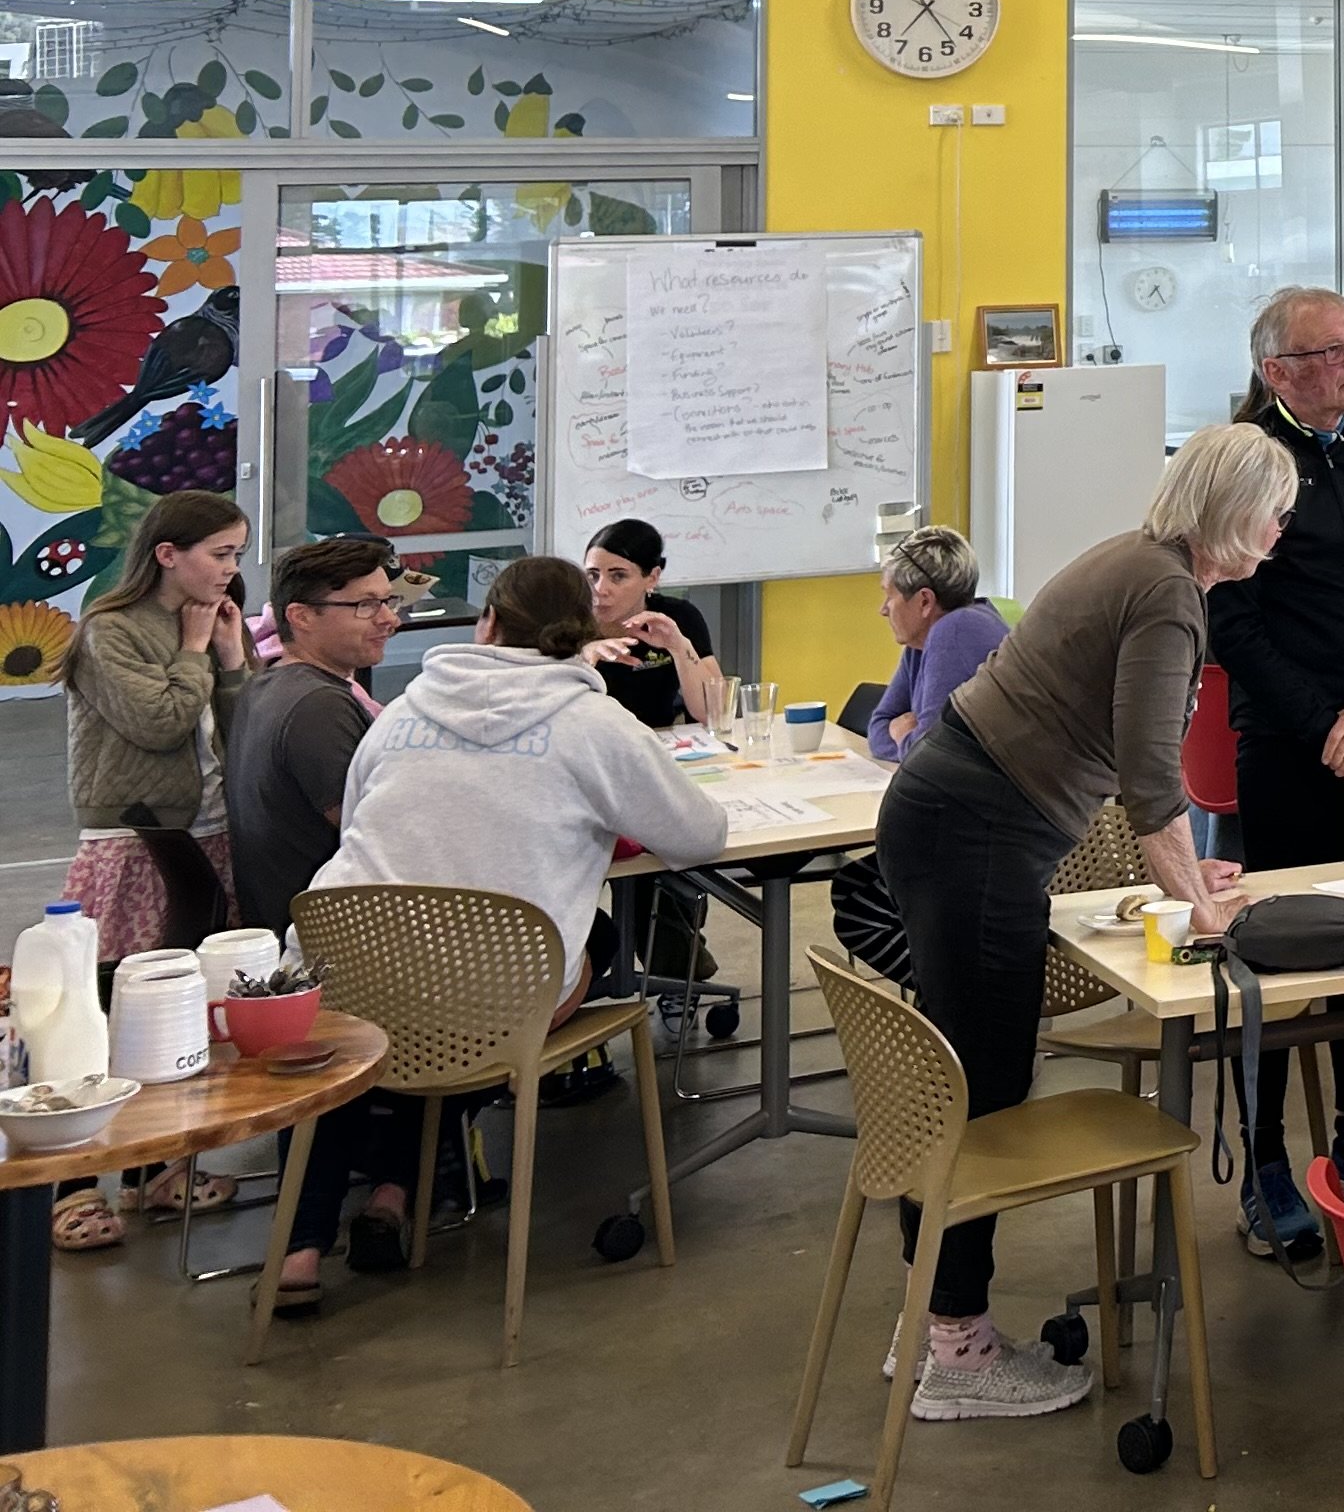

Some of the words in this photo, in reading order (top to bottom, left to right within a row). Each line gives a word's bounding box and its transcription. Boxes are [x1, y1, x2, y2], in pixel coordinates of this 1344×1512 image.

[968, 2, 983, 18] 3
[877, 22, 891, 38] 8
[959, 25, 974, 40] 4
[895, 40, 907, 55] 7
[918, 47, 932, 63] 6
[940, 41, 955, 56] 5
[650, 267, 697, 292] What
[705, 272, 782, 287] resources
[789, 269, 809, 281] do
[576, 500, 611, 519] Indoor
[176, 1048, 208, 1070] COF
